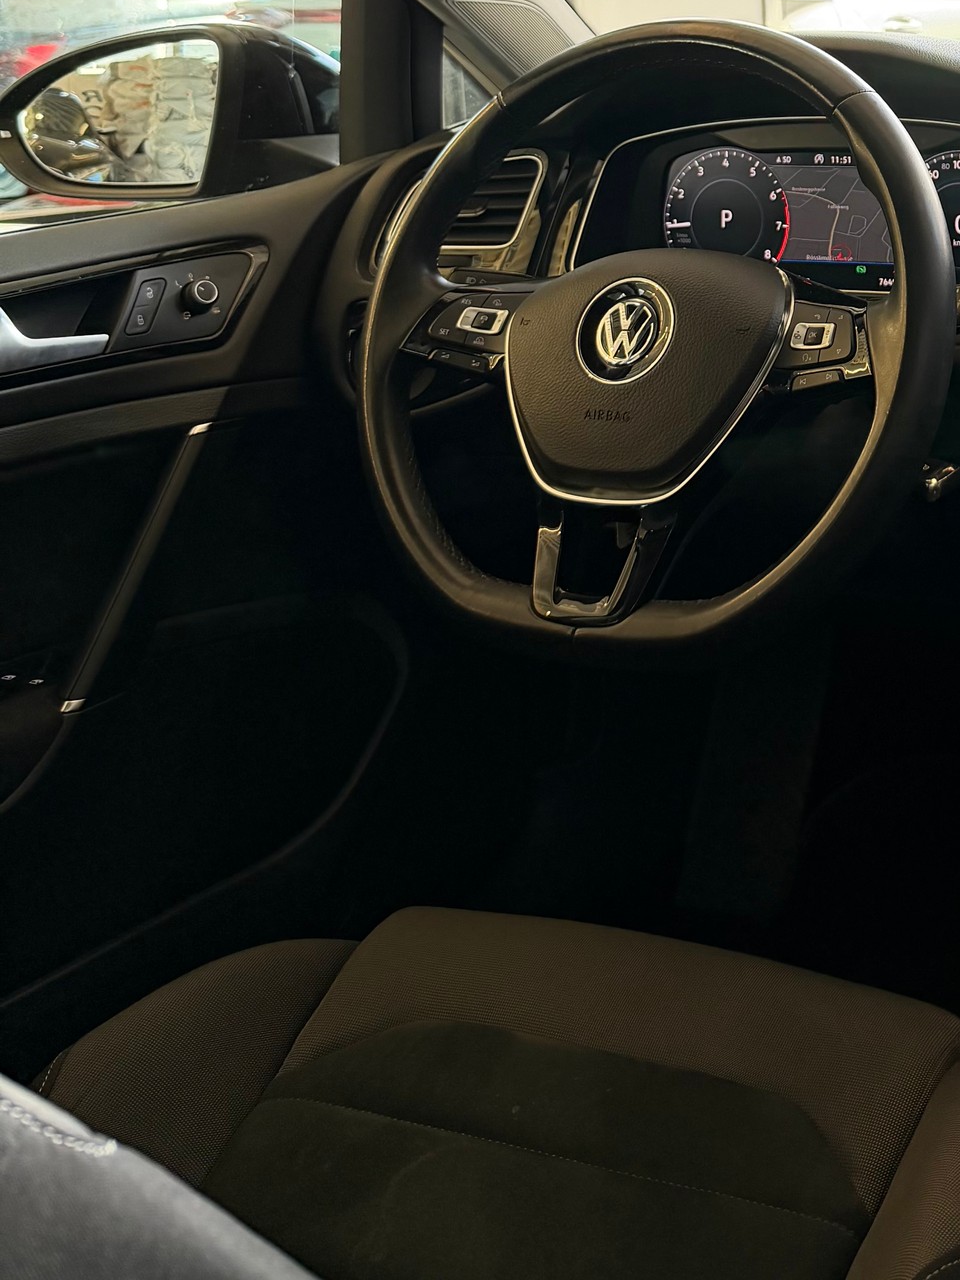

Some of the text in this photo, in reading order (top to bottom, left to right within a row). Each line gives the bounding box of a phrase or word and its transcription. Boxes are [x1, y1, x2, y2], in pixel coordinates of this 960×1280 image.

[722, 158, 730, 168] 4
[831, 156, 852, 164] 11:51
[697, 166, 705, 176] 3
[941, 162, 950, 170] 80
[749, 167, 757, 177] 5
[677, 189, 685, 199] 2
[769, 190, 777, 201] 6
[720, 209, 733, 228] P
[775, 221, 782, 231] 7
[764, 249, 771, 260] 8
[439, 328, 450, 336] SET
[583, 408, 631, 423] AIRBAG
